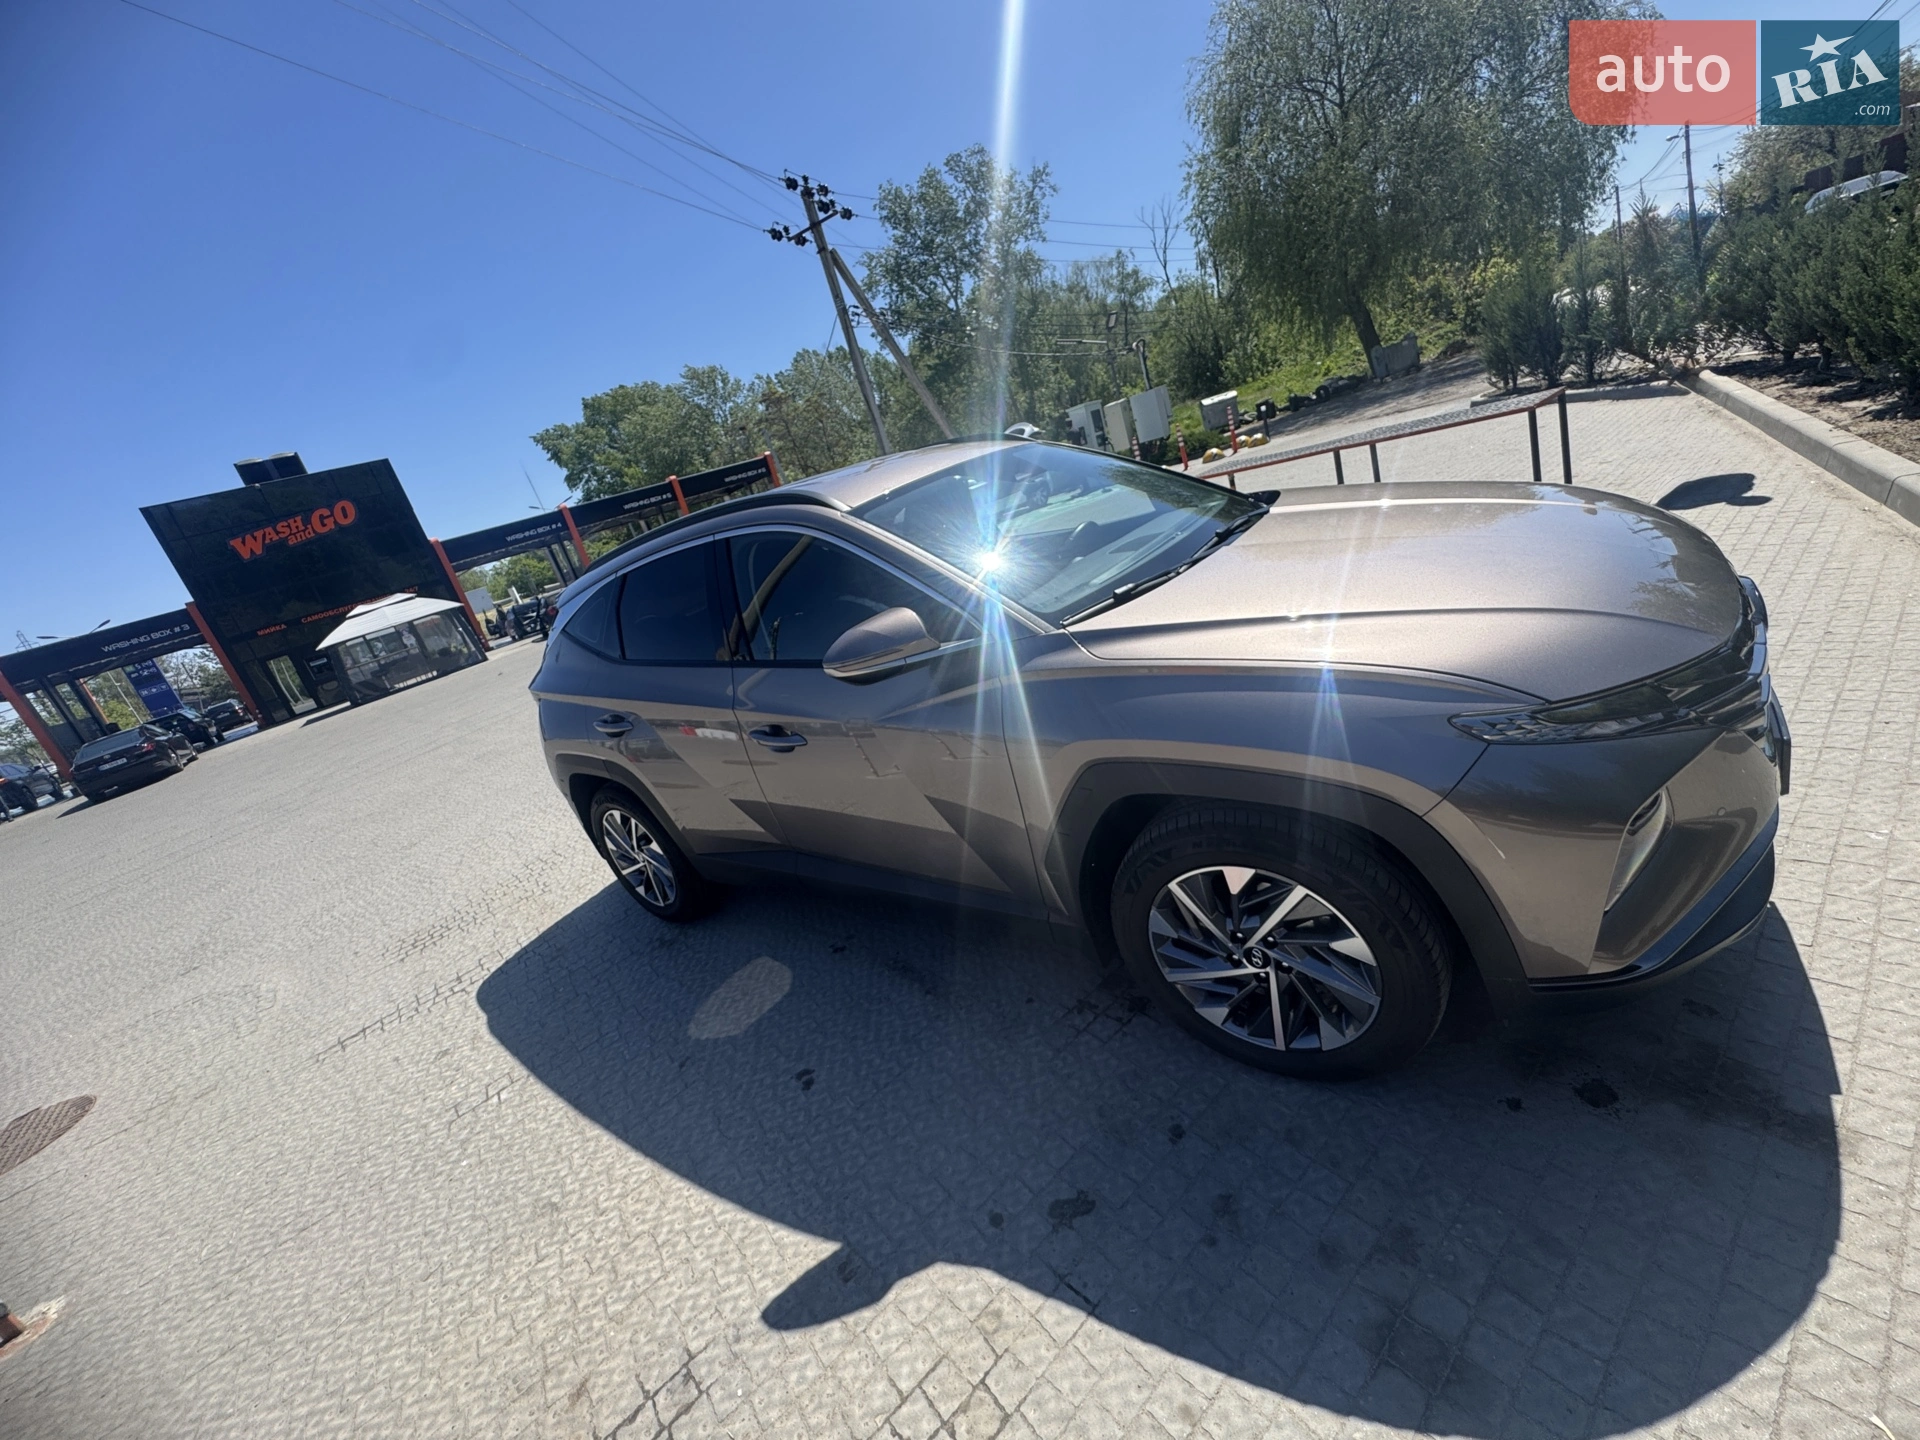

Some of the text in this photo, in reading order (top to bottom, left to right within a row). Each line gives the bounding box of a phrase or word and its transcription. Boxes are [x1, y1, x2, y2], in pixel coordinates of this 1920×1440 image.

[311, 500, 356, 534] GO
[229, 515, 305, 560] WASH
[287, 524, 316, 545] and
[505, 528, 537, 542] WASHING
[537, 526, 551, 534] BOX
[101, 634, 151, 653] WASHING
[150, 628, 173, 640] BOX
[256, 623, 287, 636] МИЙКА
